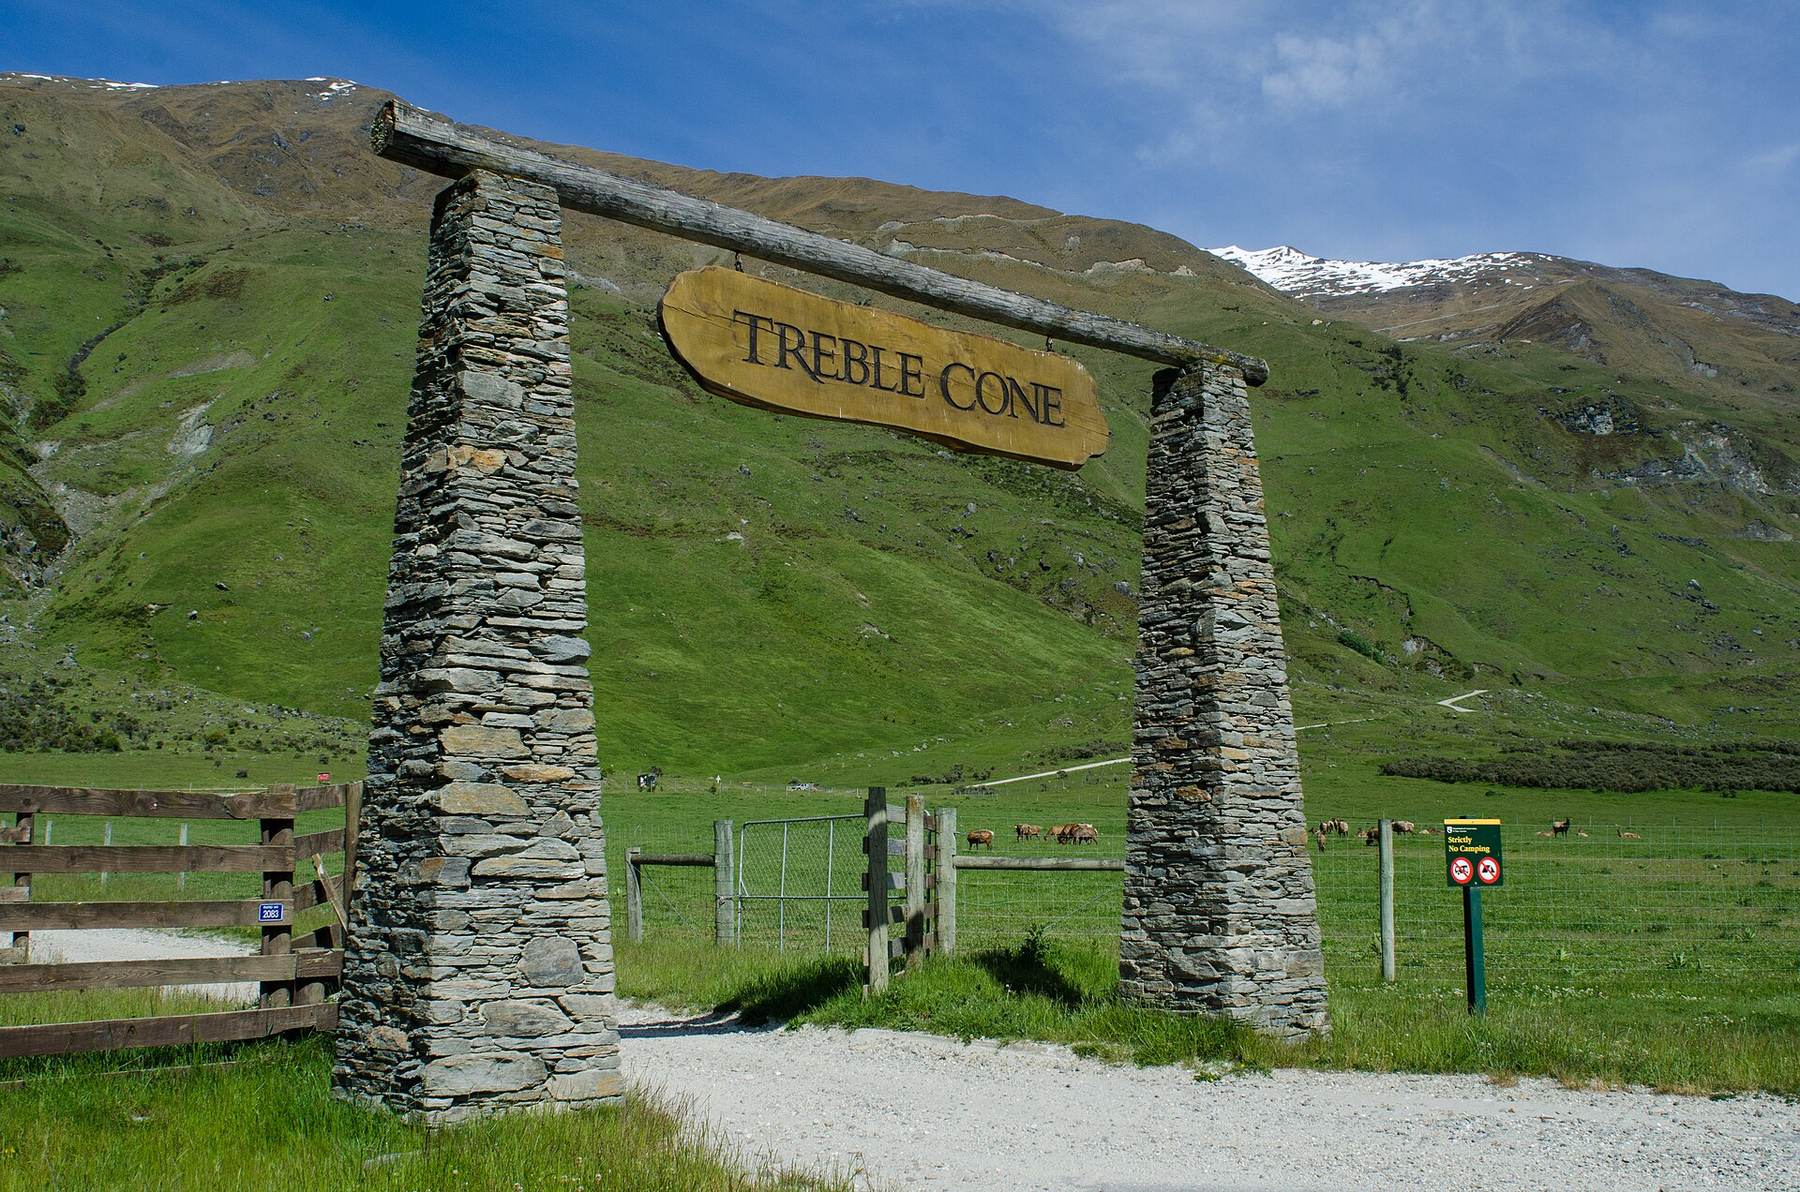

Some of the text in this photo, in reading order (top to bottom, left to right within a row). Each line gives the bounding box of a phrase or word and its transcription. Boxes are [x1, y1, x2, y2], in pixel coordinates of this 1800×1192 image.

[733, 309, 1066, 428] TREBLE CONE
[1448, 836, 1472, 845] Strictly
[1460, 845, 1490, 854] Camping
[263, 910, 279, 918] 2083
